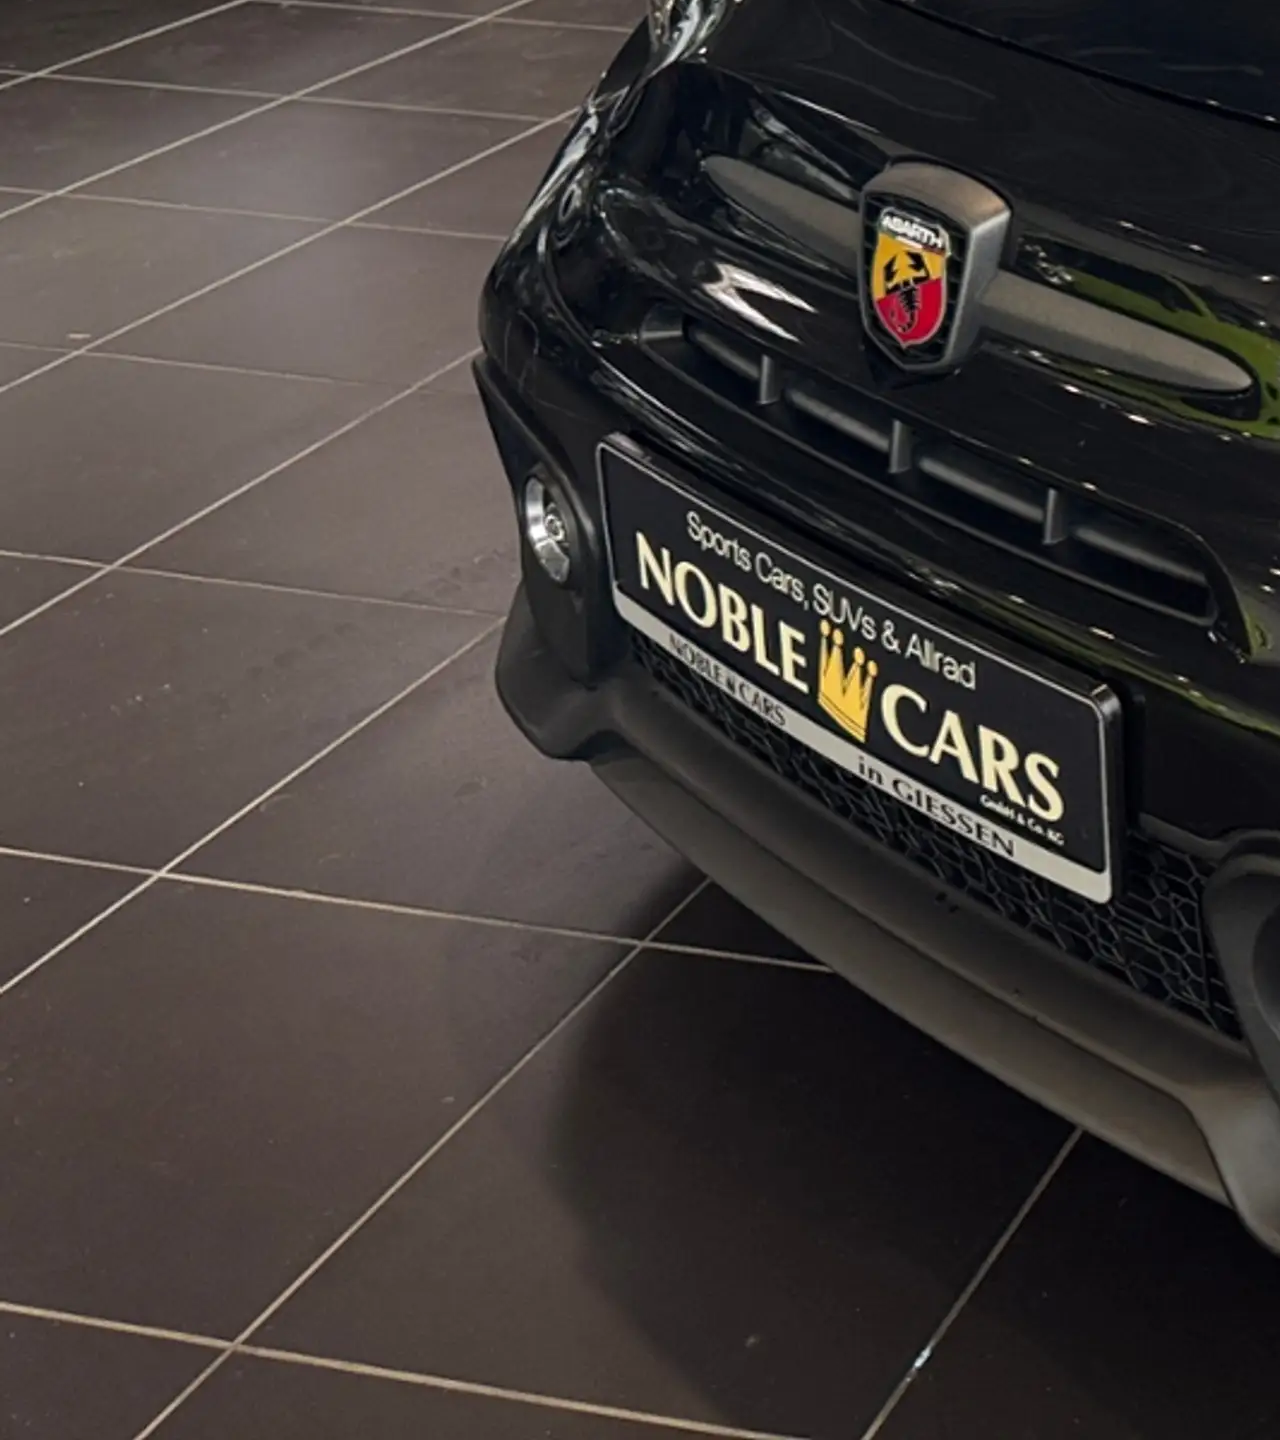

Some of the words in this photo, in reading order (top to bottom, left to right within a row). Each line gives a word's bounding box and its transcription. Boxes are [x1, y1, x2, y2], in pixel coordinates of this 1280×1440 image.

[881, 215, 946, 249] ABARTH
[685, 510, 752, 573] Sports
[755, 552, 811, 611] Cars,
[812, 583, 877, 641] SUVs
[880, 619, 902, 655] &
[904, 633, 977, 691] Allrad
[635, 530, 810, 695] NOBLE
[880, 683, 1065, 823] CARS
[738, 681, 787, 727] CARS
[857, 755, 884, 787] in
[892, 776, 1016, 858] GIESSEN
